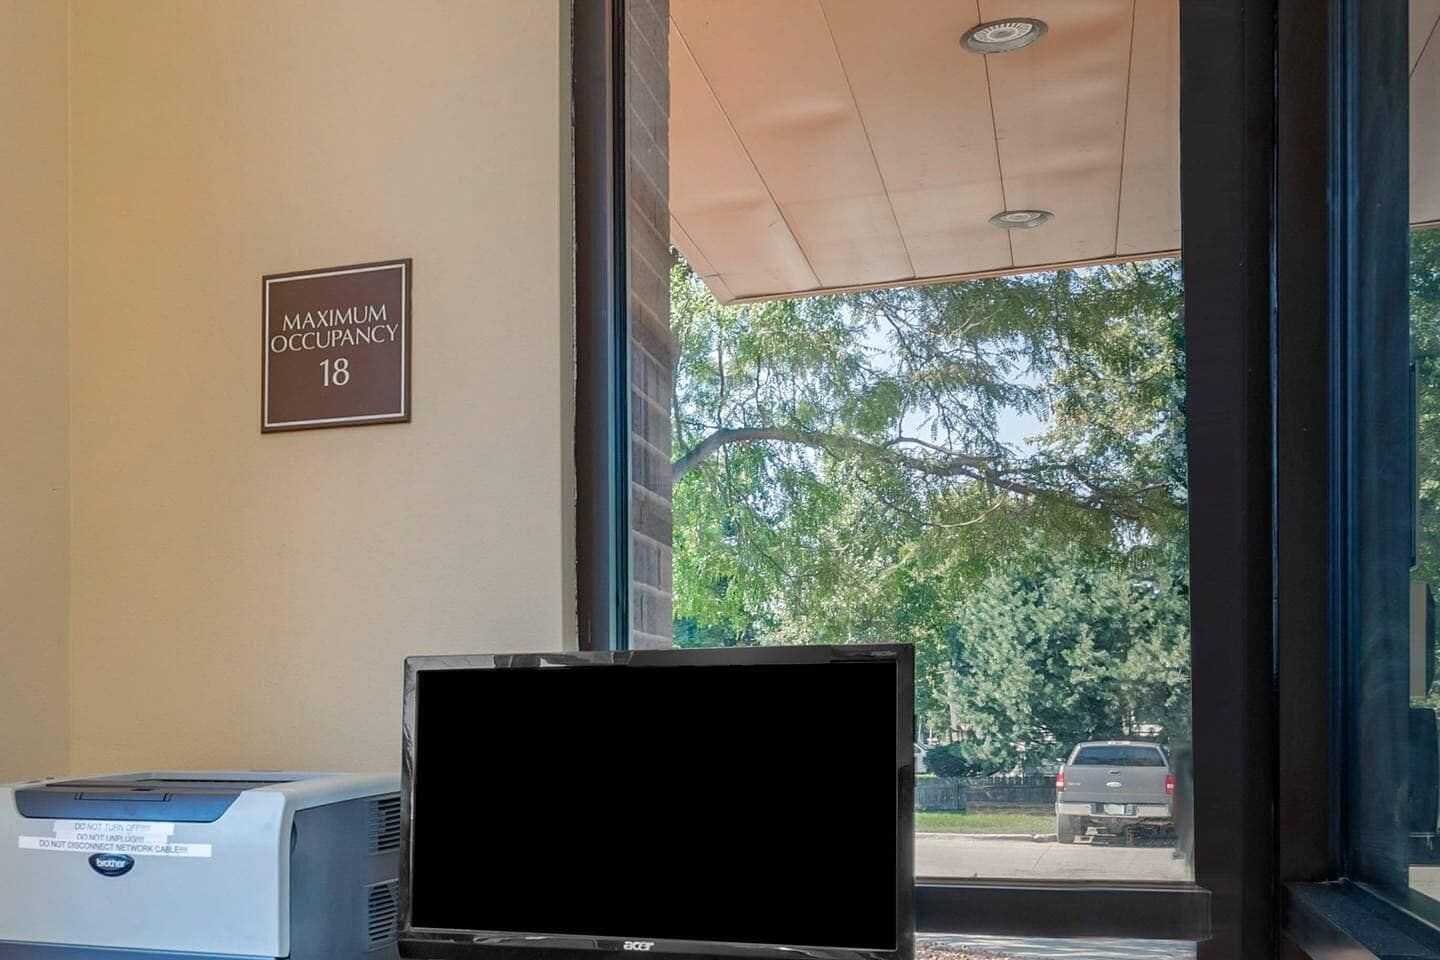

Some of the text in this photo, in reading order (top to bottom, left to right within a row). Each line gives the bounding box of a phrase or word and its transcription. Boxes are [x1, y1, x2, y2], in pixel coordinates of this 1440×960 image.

[282, 304, 387, 332] MAXIMUM
[270, 323, 399, 353] OCCUPANCY
[319, 357, 350, 387] 18
[74, 822, 86, 830] DO
[87, 823, 102, 831] NOT
[105, 824, 124, 832] TURN
[39, 840, 49, 848] DO
[51, 840, 66, 848] NOT
[67, 841, 114, 850] DISCONNECT
[116, 843, 153, 852] NETWORK
[95, 857, 126, 868] brother
[623, 941, 655, 951] acer
